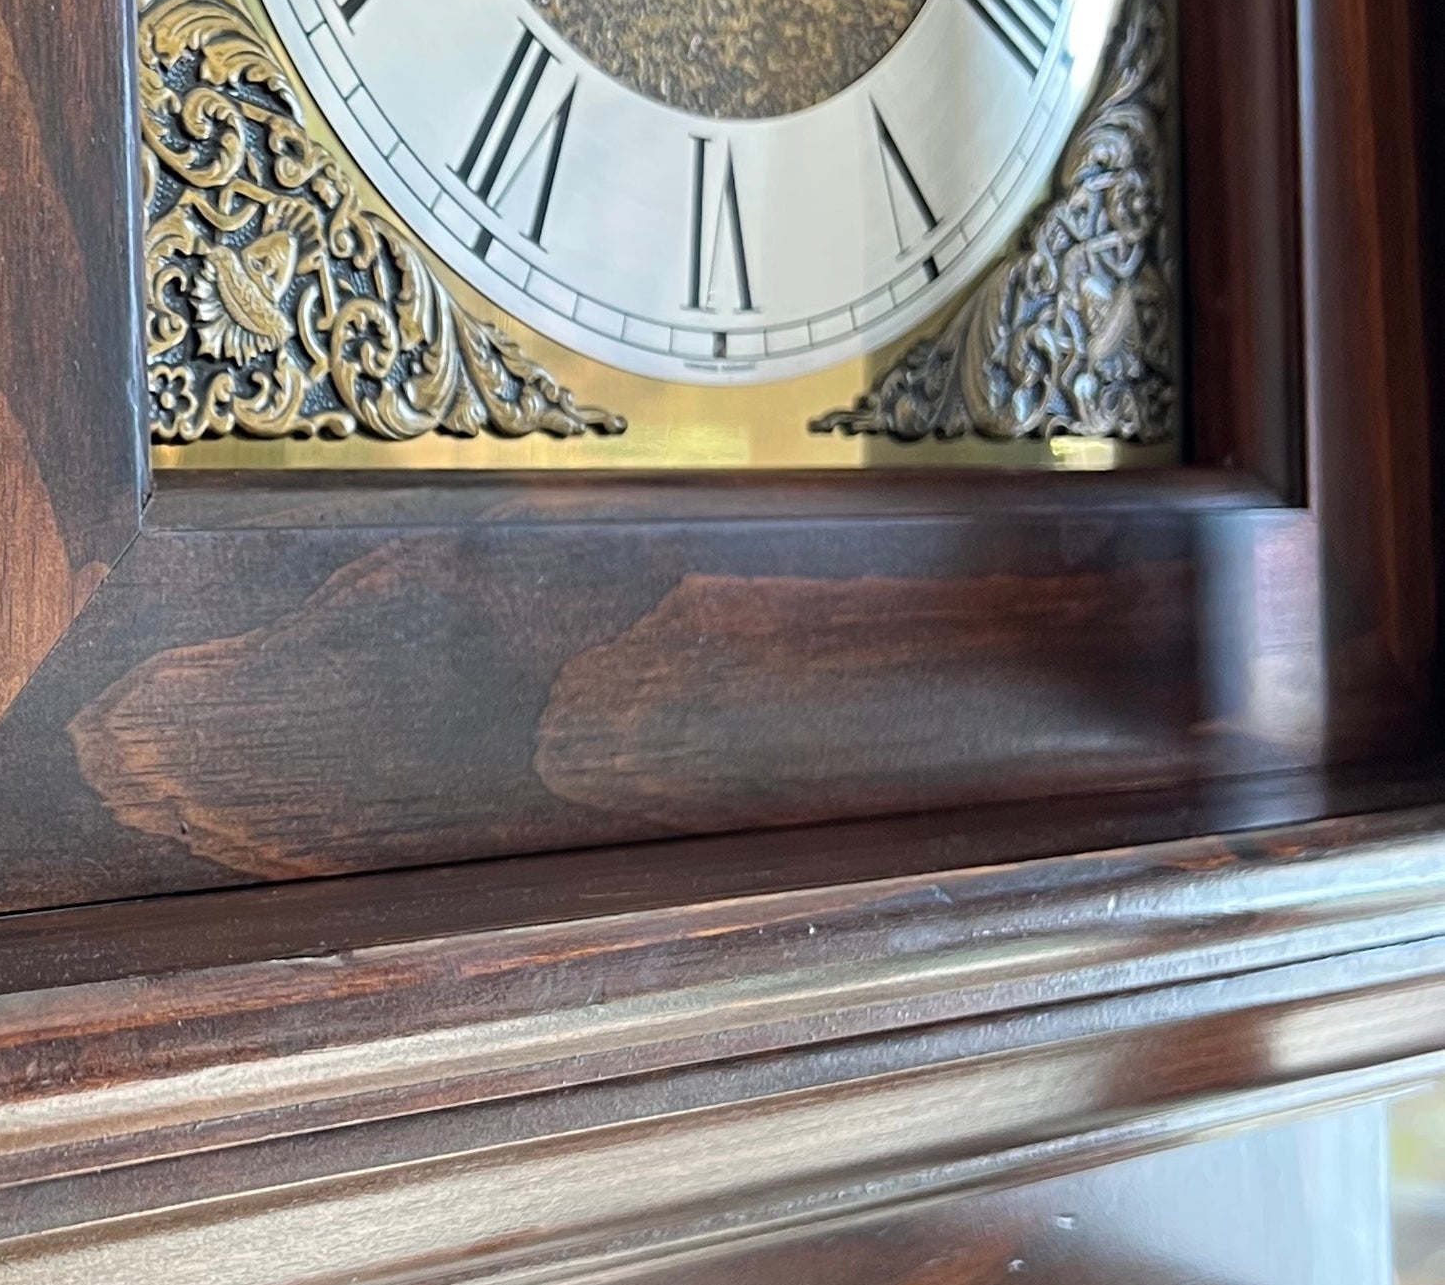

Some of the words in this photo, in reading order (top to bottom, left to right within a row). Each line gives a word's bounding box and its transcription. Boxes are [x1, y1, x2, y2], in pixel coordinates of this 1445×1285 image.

[447, 16, 581, 253] VII
[680, 134, 762, 313] VI
[867, 92, 944, 258] V
